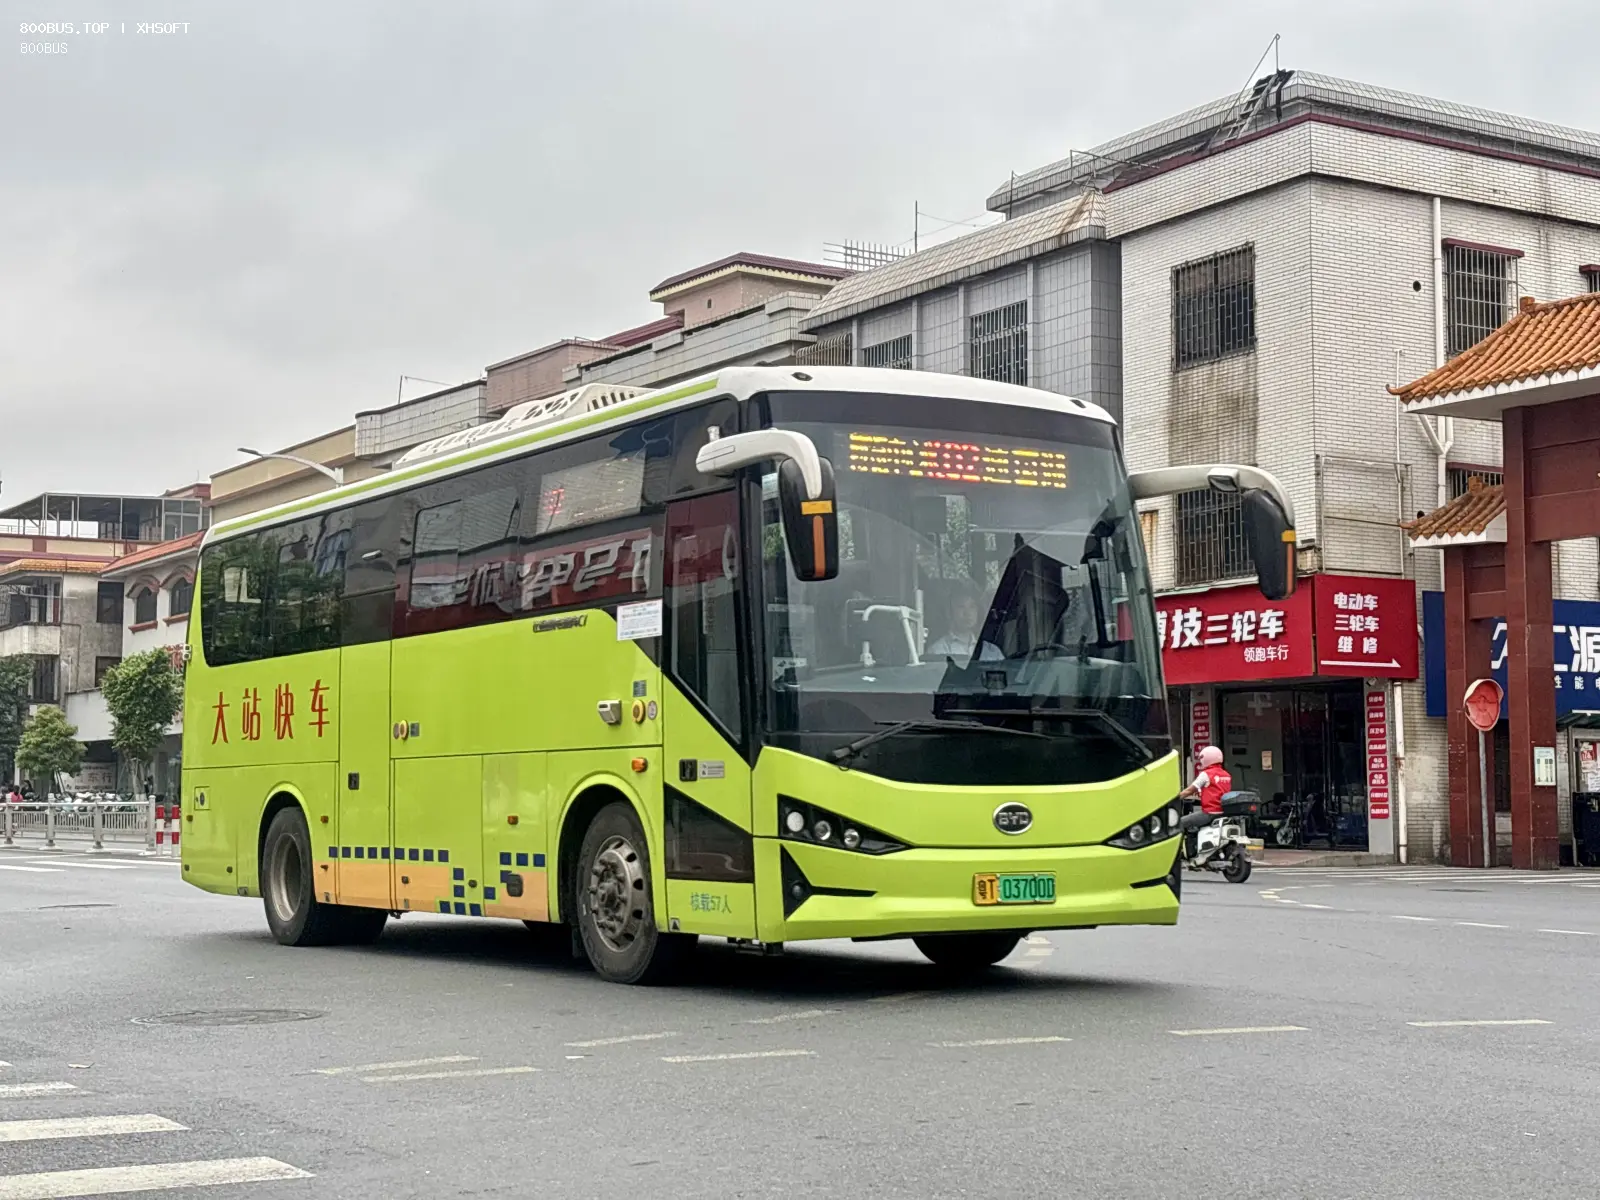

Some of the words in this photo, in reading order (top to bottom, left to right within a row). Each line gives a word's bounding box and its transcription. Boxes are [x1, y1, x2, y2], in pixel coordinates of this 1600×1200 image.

[1333, 591, 1378, 611] 电动车
[1334, 614, 1380, 632] 三轮车
[1243, 645, 1289, 663] 领跑车行
[211, 678, 330, 745] 大站快车
[998, 811, 1029, 826] BYD
